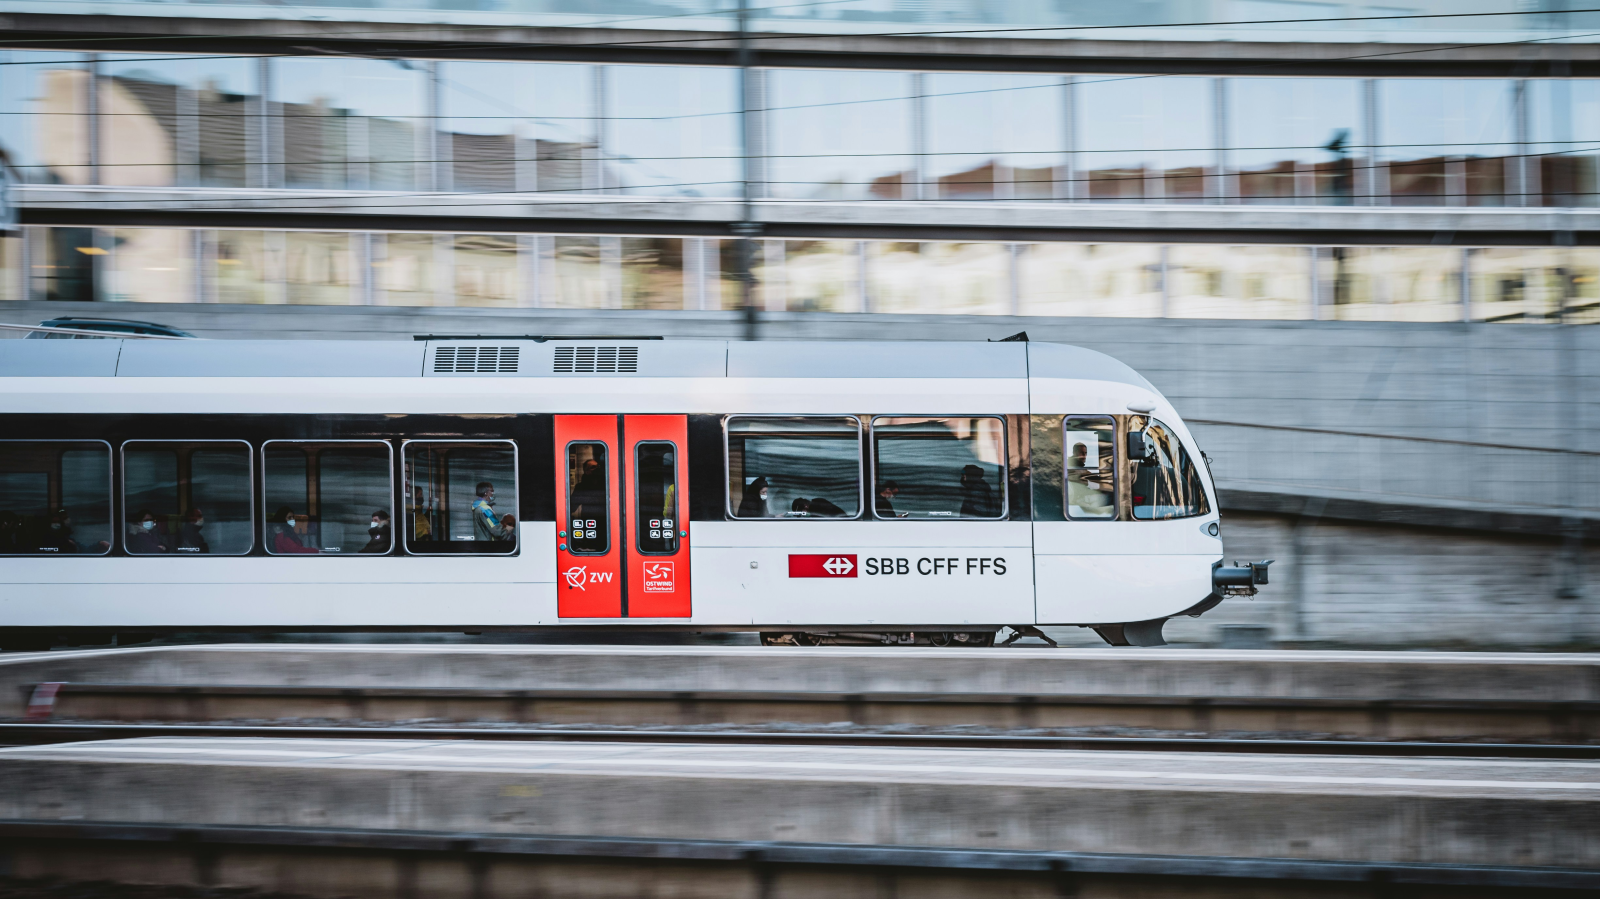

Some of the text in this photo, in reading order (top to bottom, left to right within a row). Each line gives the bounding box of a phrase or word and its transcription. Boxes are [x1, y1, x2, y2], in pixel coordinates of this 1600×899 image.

[865, 557, 1007, 576] SBB CFF FFS
[589, 572, 613, 583] ZVV
